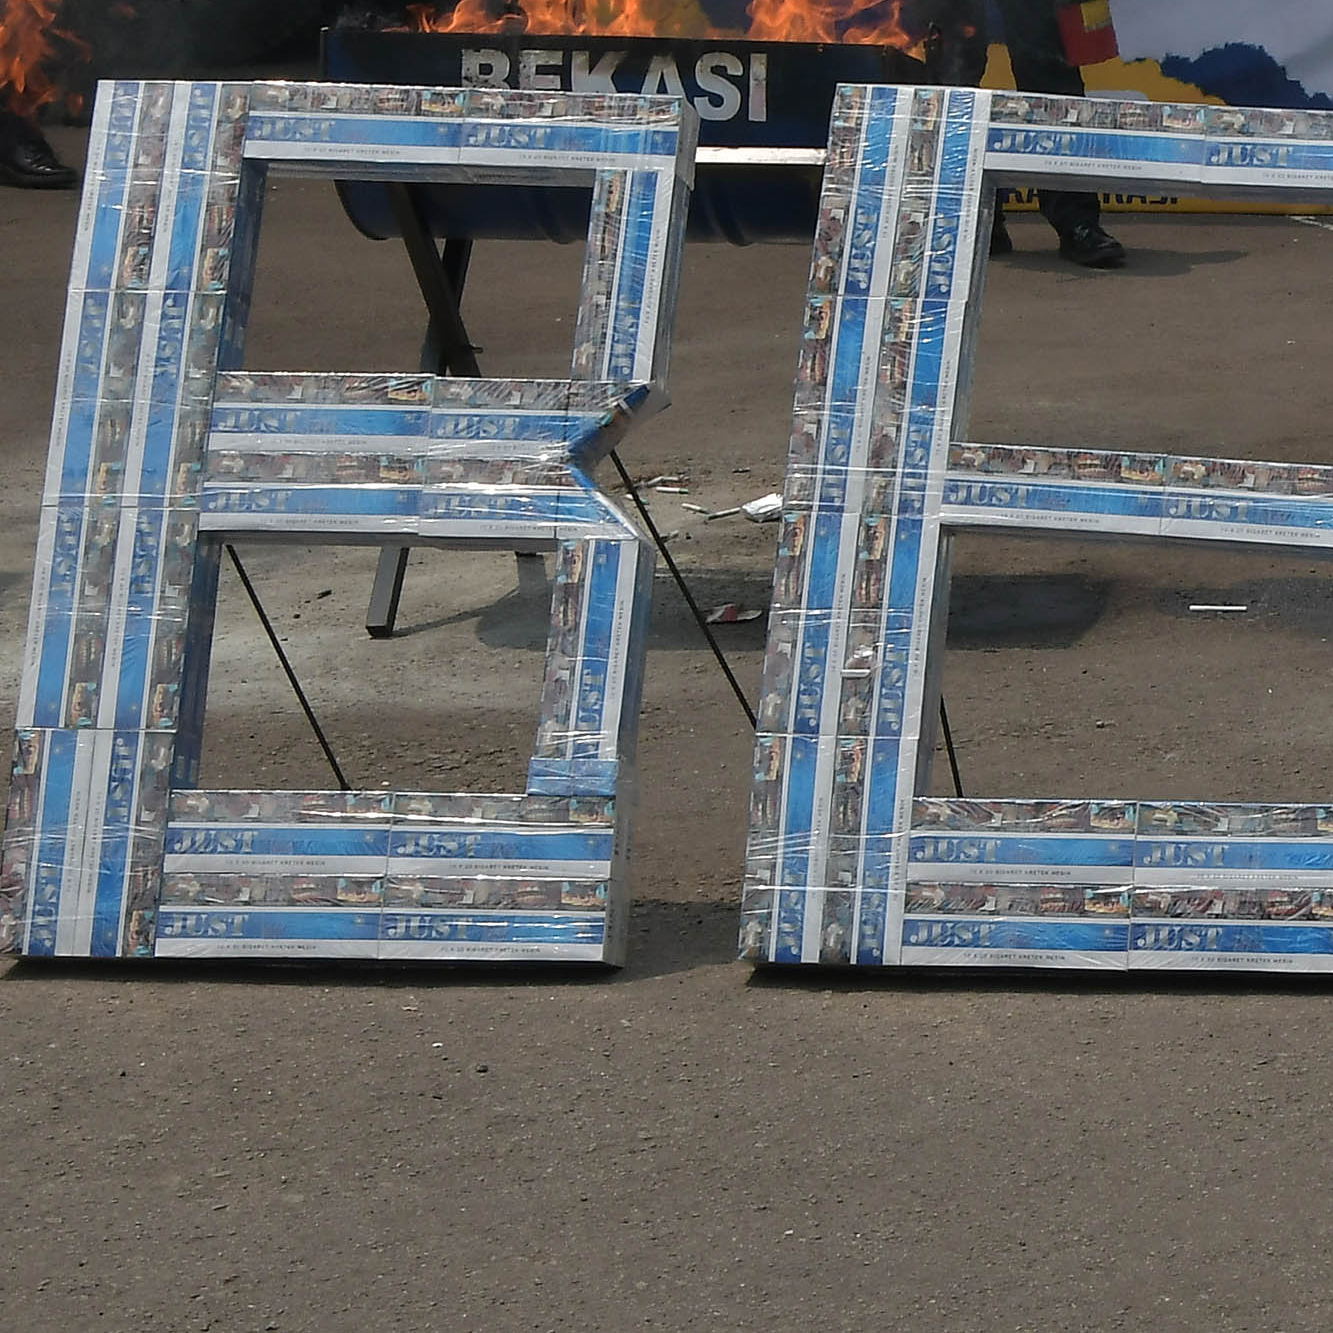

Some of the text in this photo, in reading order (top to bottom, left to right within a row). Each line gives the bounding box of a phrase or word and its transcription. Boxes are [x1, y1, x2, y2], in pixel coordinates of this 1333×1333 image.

[461, 48, 767, 122] BEKASI
[467, 124, 553, 149] JUST
[993, 129, 1078, 156] JUST
[1209, 143, 1294, 168] JUST
[946, 482, 1033, 508] JUST
[1167, 496, 1253, 521] JUST
[173, 829, 259, 854] JUST
[396, 833, 482, 858] JUST
[914, 837, 1000, 862] JUST
[1142, 842, 1229, 867] JUST
[163, 913, 249, 938] JUST
[387, 915, 473, 940] JUST
[909, 921, 996, 946] JUST
[1136, 924, 1229, 949] JUST
